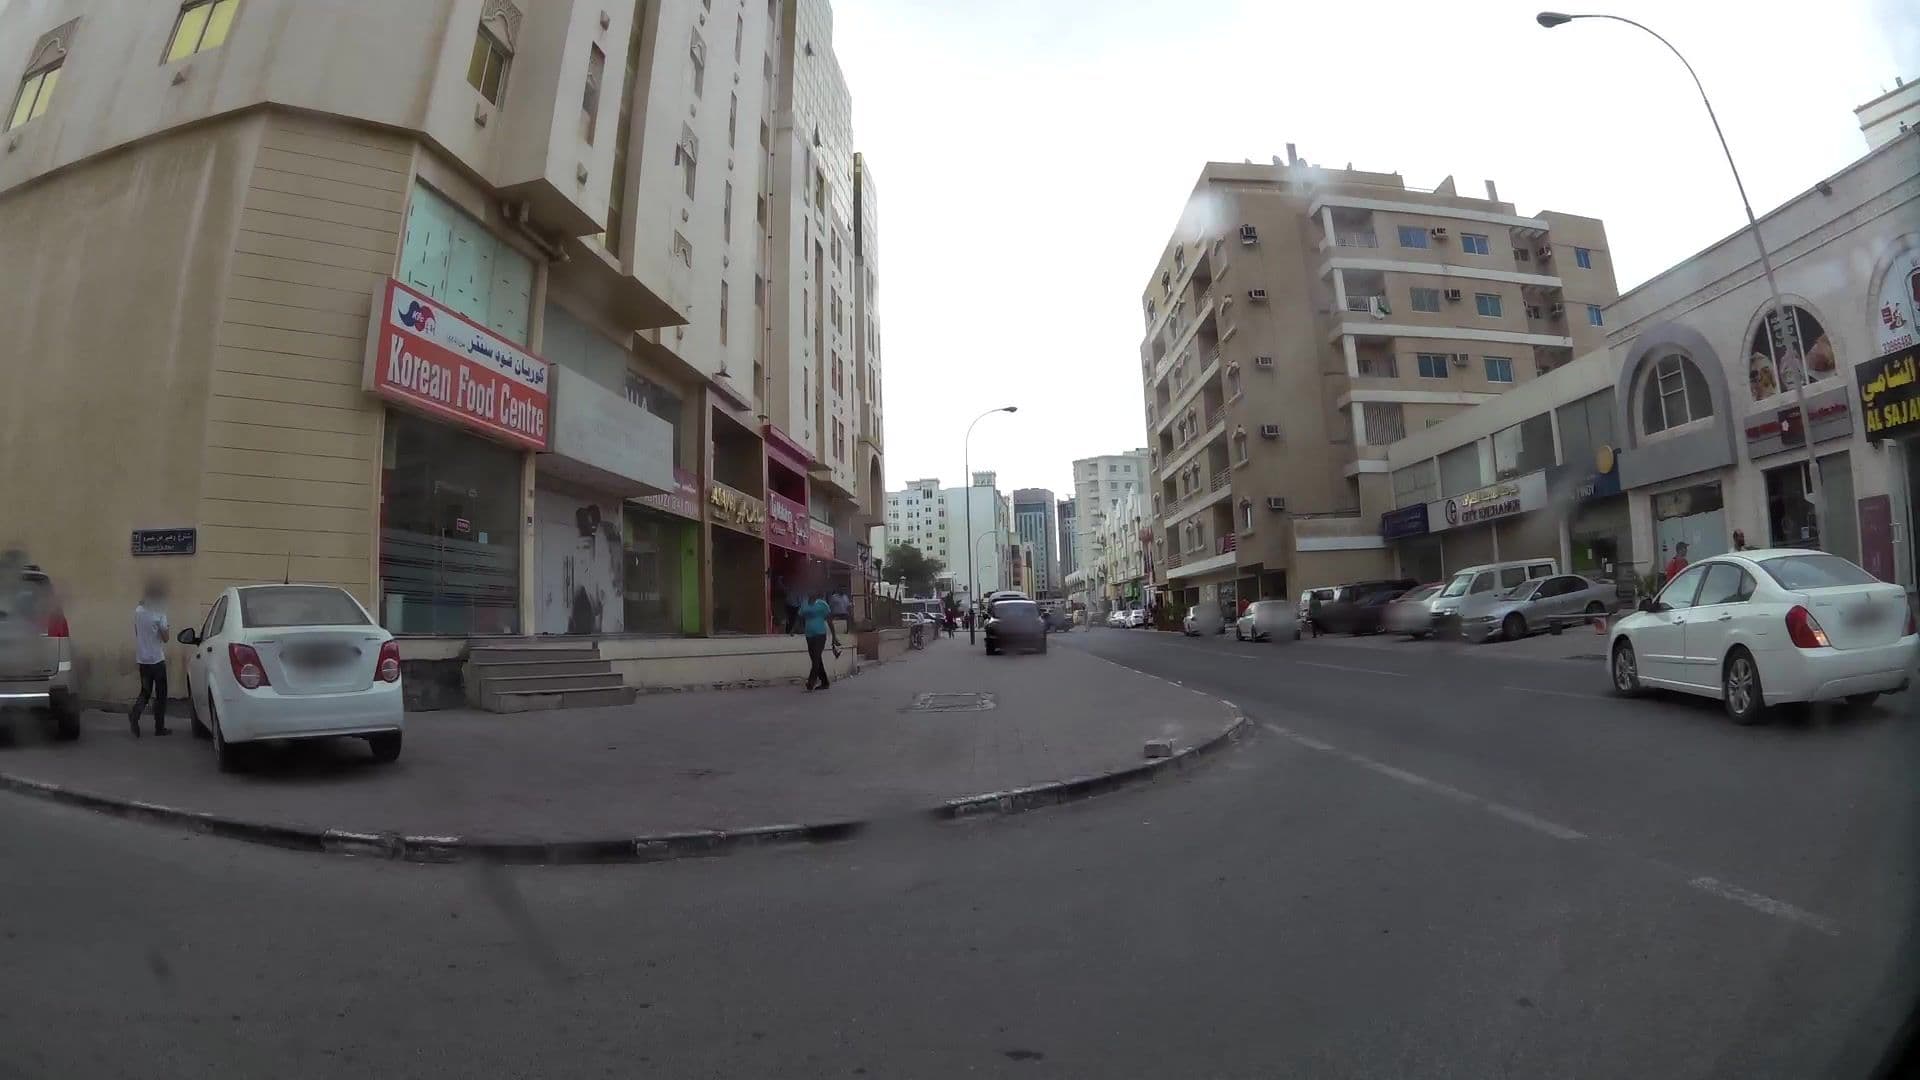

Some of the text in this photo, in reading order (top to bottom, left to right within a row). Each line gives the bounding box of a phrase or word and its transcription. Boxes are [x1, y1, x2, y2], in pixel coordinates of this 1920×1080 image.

[387, 334, 545, 437] Korean Food Centre
[1867, 407, 1883, 433] AL
